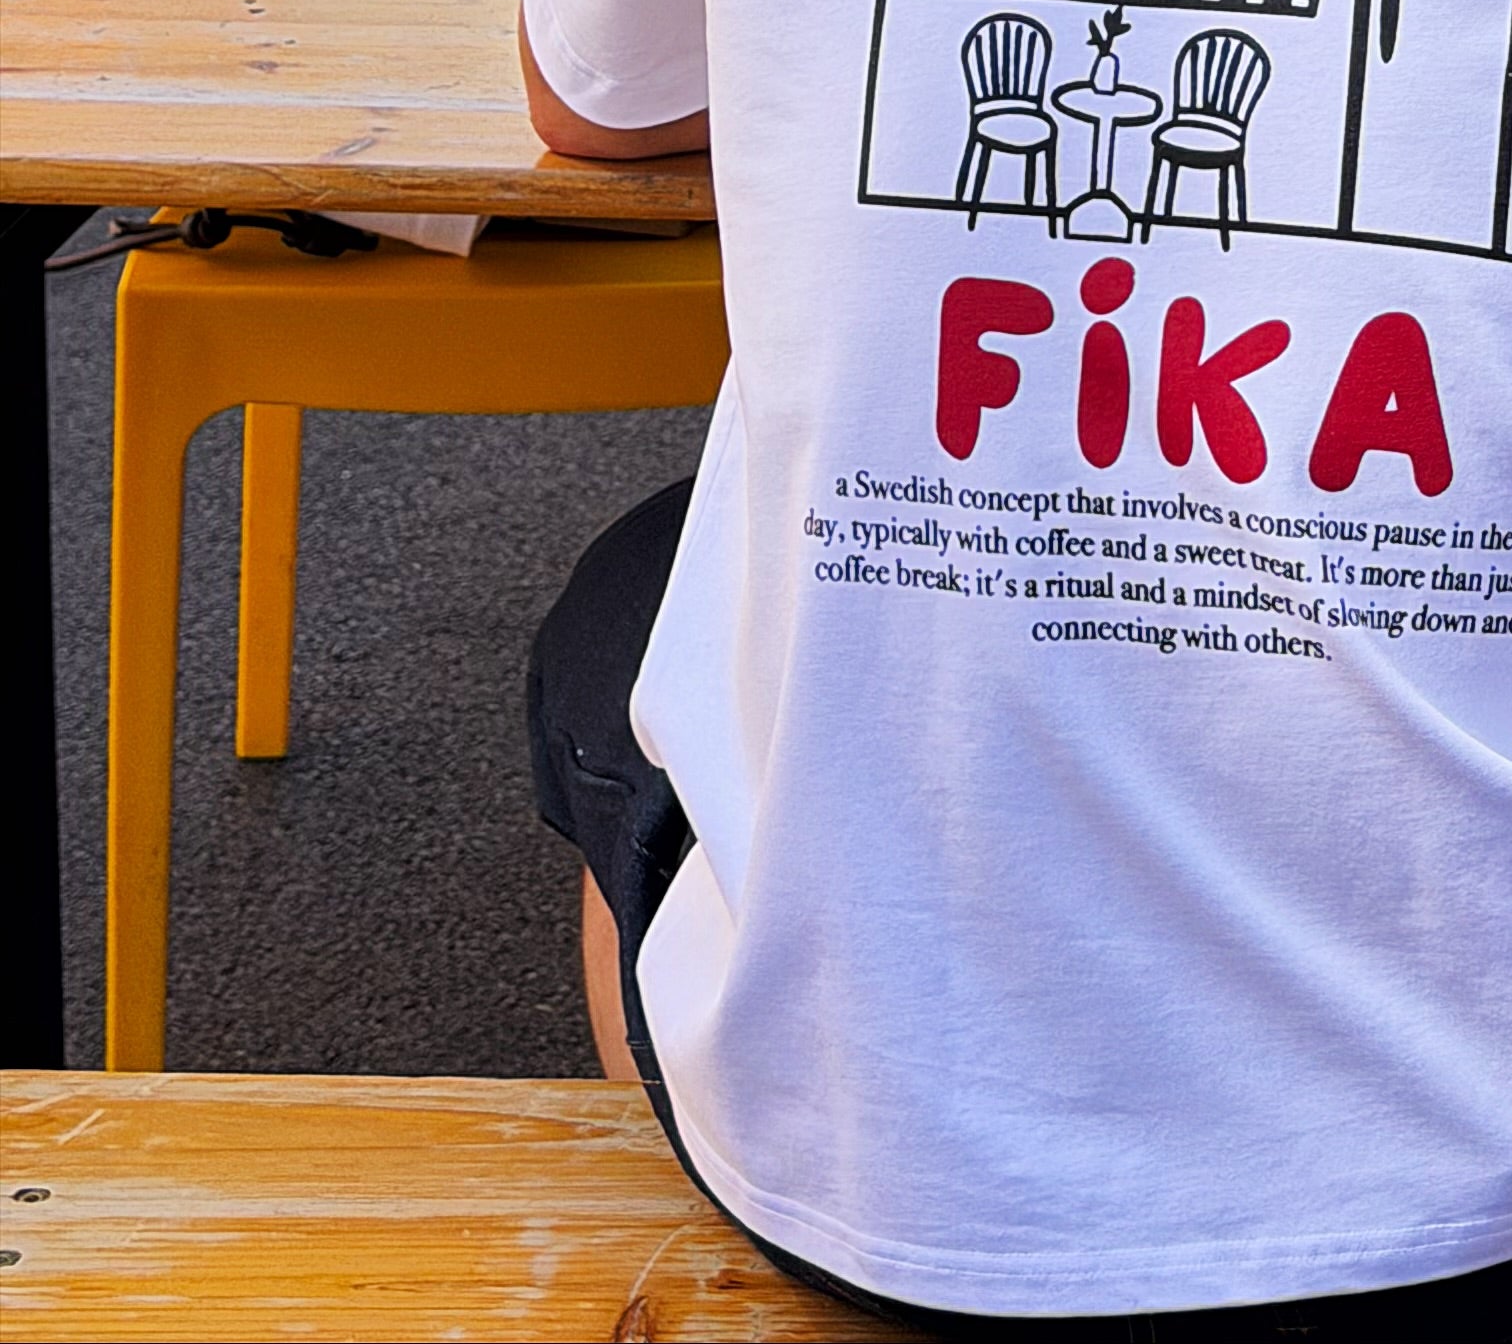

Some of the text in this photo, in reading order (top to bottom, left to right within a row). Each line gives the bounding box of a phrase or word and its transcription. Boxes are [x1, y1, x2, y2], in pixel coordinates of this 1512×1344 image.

[804, 508, 845, 546] day,
[852, 516, 951, 556] typically
[956, 525, 1008, 554] with
[1015, 529, 1095, 556] coffee
[1102, 534, 1146, 562] and
[1154, 543, 1166, 562] a
[1175, 542, 1247, 568] sweet
[1251, 552, 1311, 583] treat.
[1321, 554, 1354, 584] It's
[1361, 566, 1425, 589] more
[1431, 564, 1482, 592] than
[835, 477, 848, 497] a
[854, 470, 953, 506] Swedish
[959, 488, 1061, 521] concept
[1067, 487, 1116, 516] that
[1122, 490, 1223, 524] involves
[1229, 512, 1240, 528] a
[1246, 512, 1367, 542] conscious
[1372, 523, 1446, 550] pause
[1451, 522, 1474, 549] in
[815, 555, 890, 584] coffee
[897, 559, 970, 596] break;
[976, 569, 1017, 598] it's
[1024, 579, 1038, 598] a
[1046, 572, 1114, 599] ritual
[1121, 577, 1165, 604] and
[1174, 587, 1187, 606] a
[1194, 581, 1294, 616] mindset
[1298, 599, 1324, 624] of
[1327, 599, 1406, 638] slowing
[1411, 604, 1475, 634] down
[1032, 616, 1332, 661] connecting with others.
